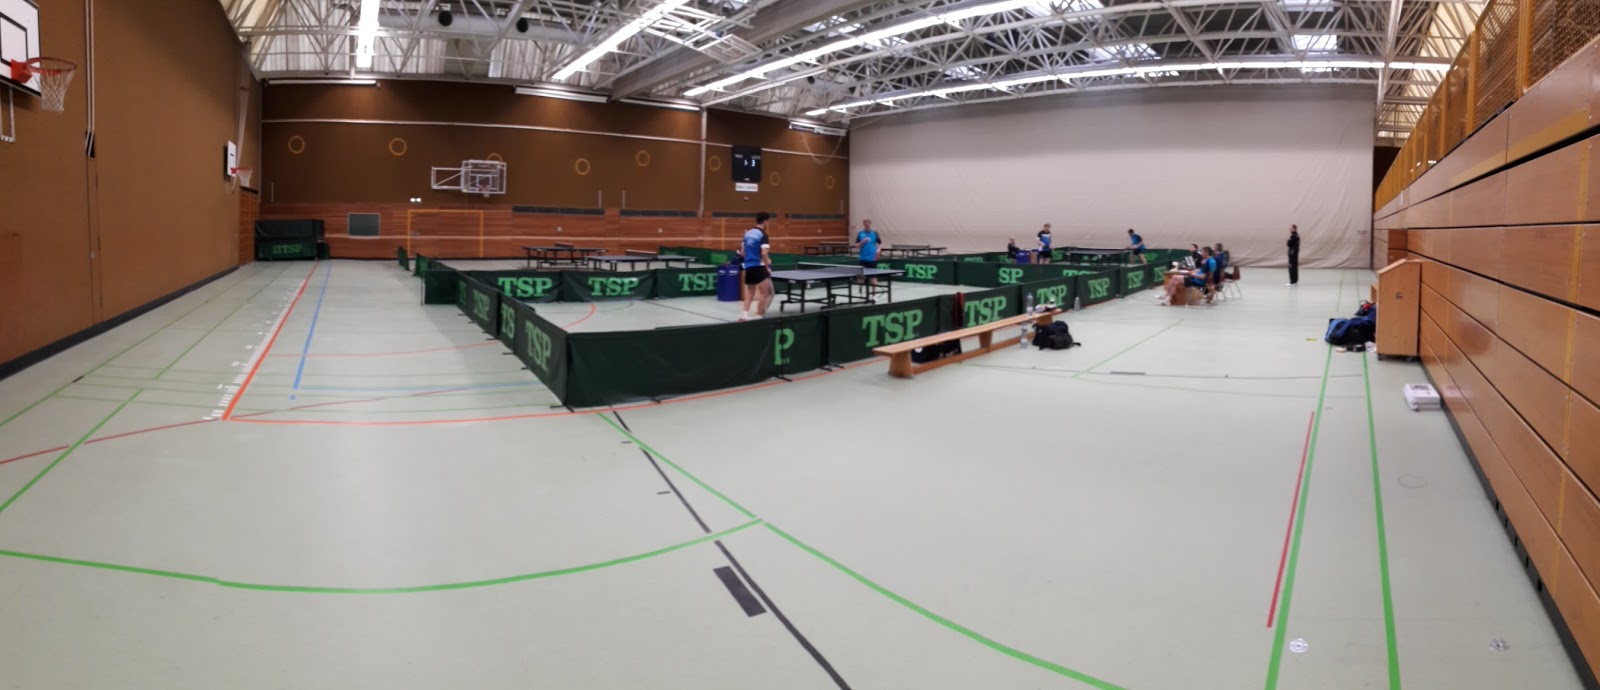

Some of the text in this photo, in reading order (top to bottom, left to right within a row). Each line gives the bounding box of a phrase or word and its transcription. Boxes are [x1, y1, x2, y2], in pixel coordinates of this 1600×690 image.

[905, 264, 937, 279] TSP
[1127, 270, 1145, 289] TSP
[498, 277, 553, 297] TSP
[589, 277, 639, 296] TSP
[1037, 284, 1067, 308] TSP
[1088, 278, 1110, 299] TSP
[965, 296, 1007, 327] TSP
[862, 309, 924, 348] TSP
[525, 319, 552, 372] TSP
[774, 328, 795, 366] P
